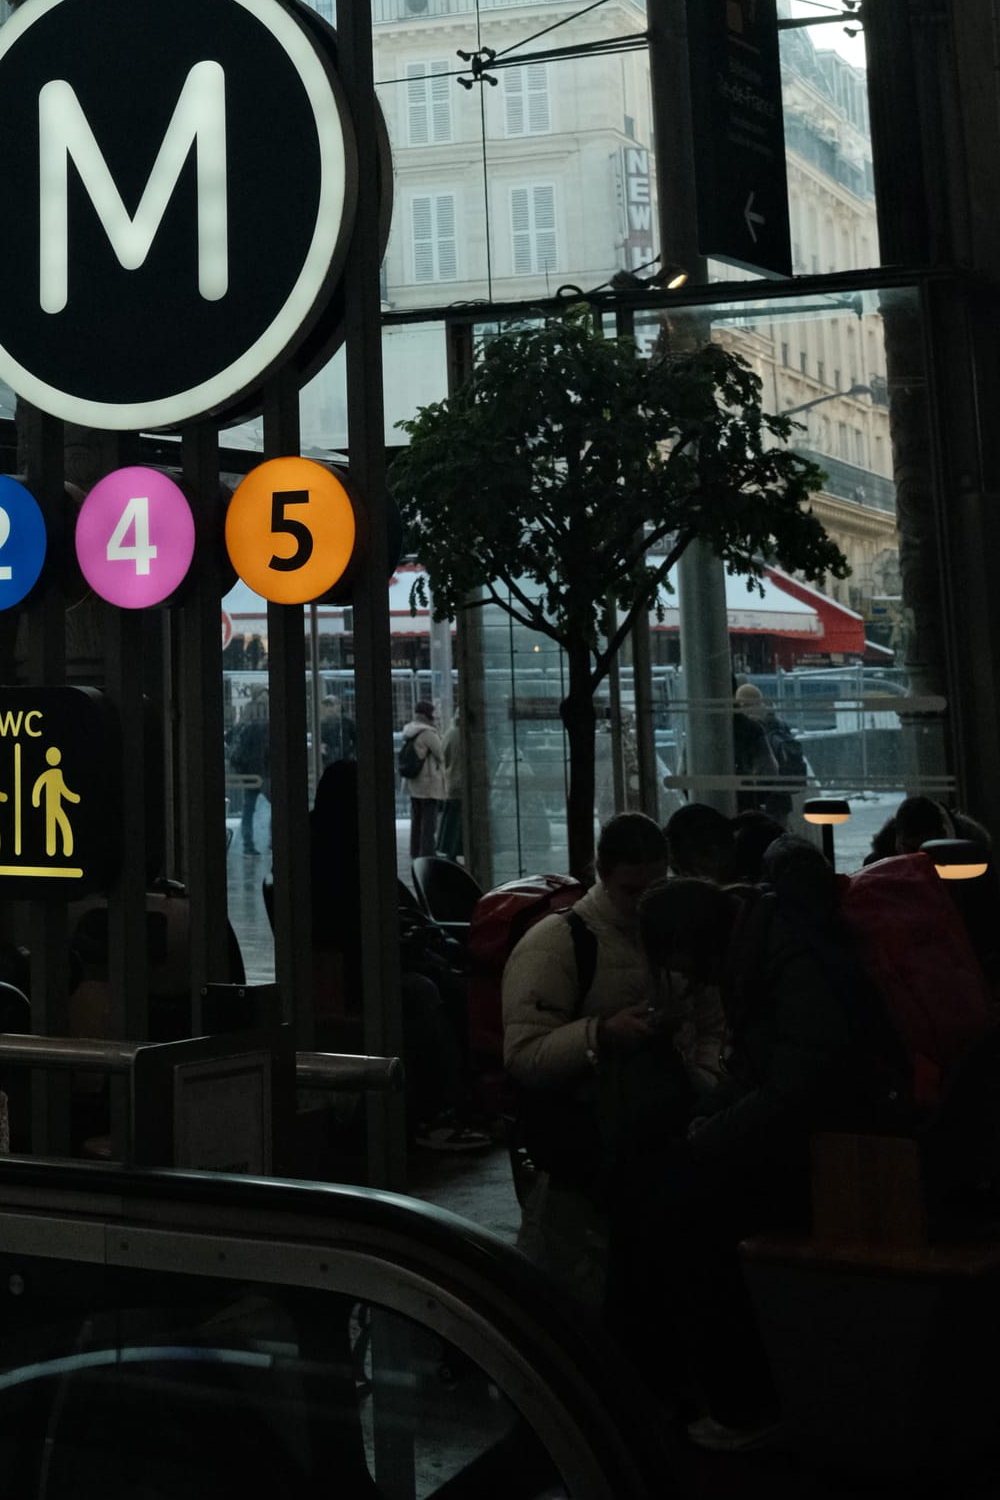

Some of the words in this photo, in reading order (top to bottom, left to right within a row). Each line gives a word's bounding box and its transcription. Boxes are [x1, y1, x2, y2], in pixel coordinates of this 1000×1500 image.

[39, 60, 228, 314] M
[627, 149, 650, 231] NEW
[106, 497, 157, 575] 4
[268, 490, 313, 572] 5
